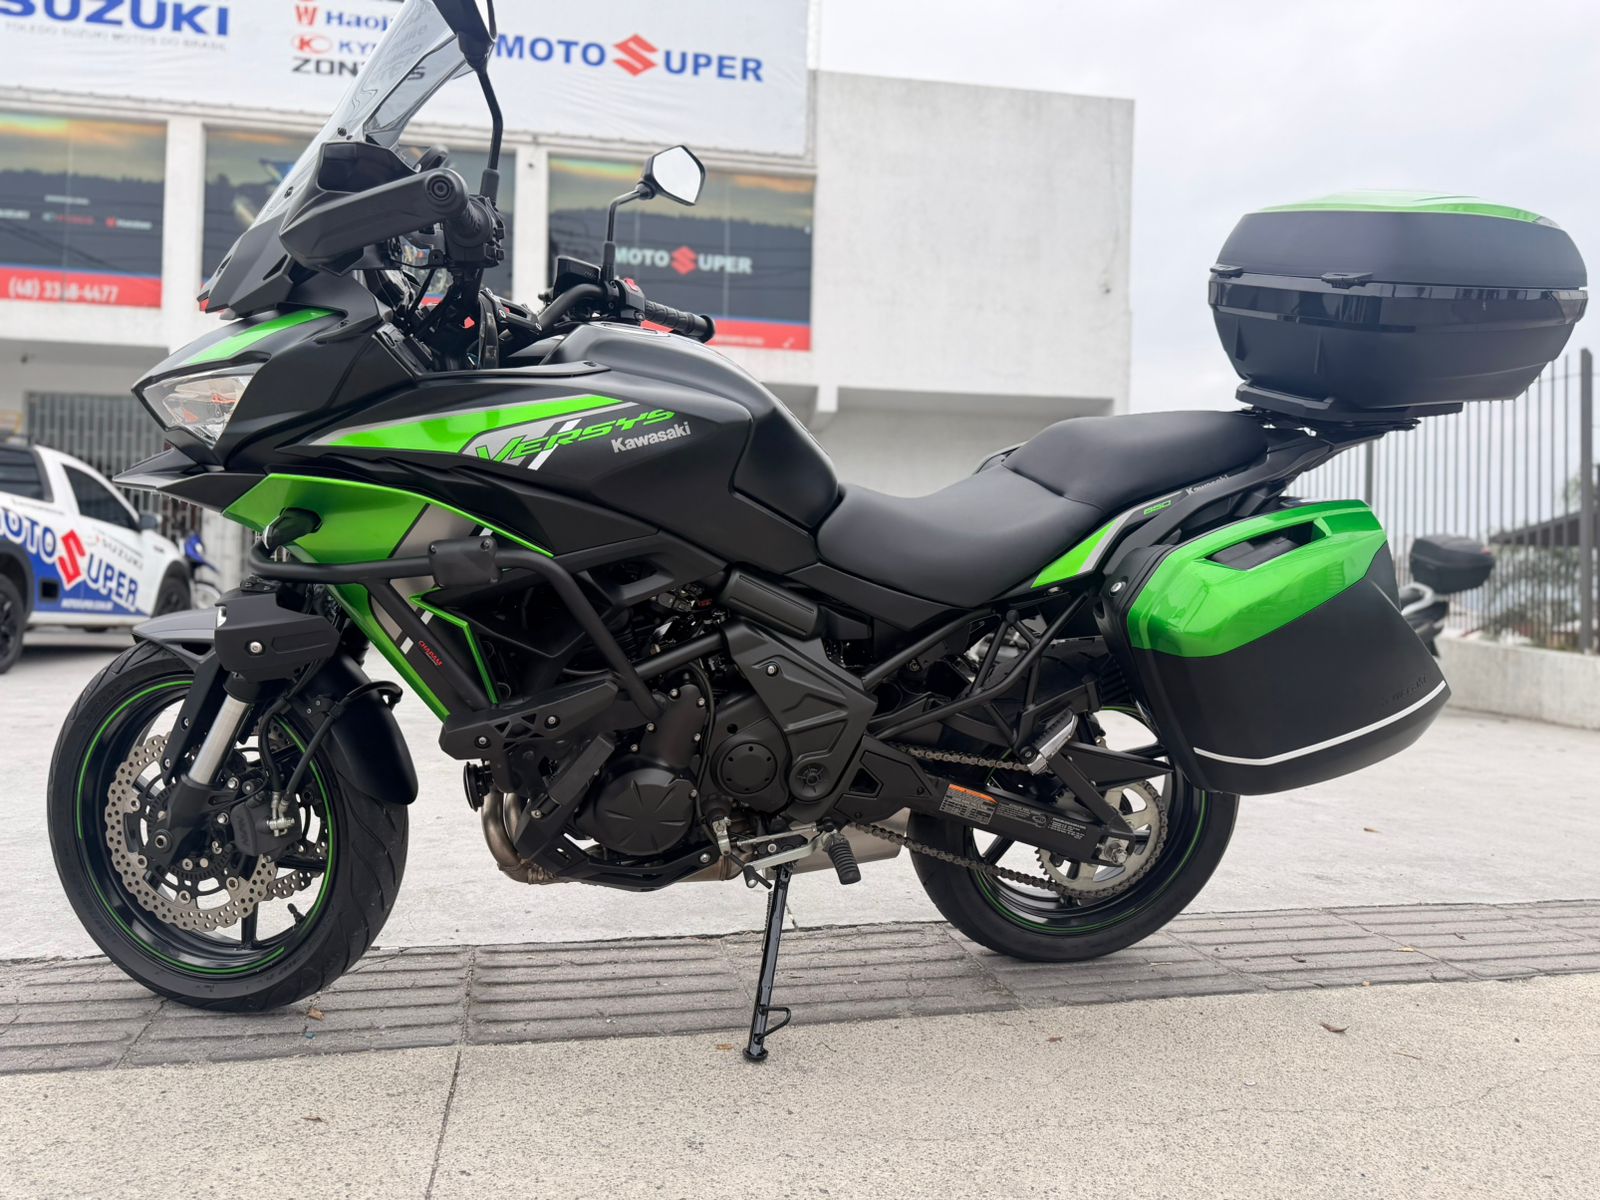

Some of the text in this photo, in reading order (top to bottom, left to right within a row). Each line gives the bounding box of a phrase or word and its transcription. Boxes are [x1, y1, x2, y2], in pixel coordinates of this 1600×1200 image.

[496, 33, 606, 67] MOTO
[614, 247, 670, 268] MOTO
[475, 408, 676, 463] VERSYS
[611, 421, 692, 454] Kawasaki
[0, 507, 57, 558] OTO
